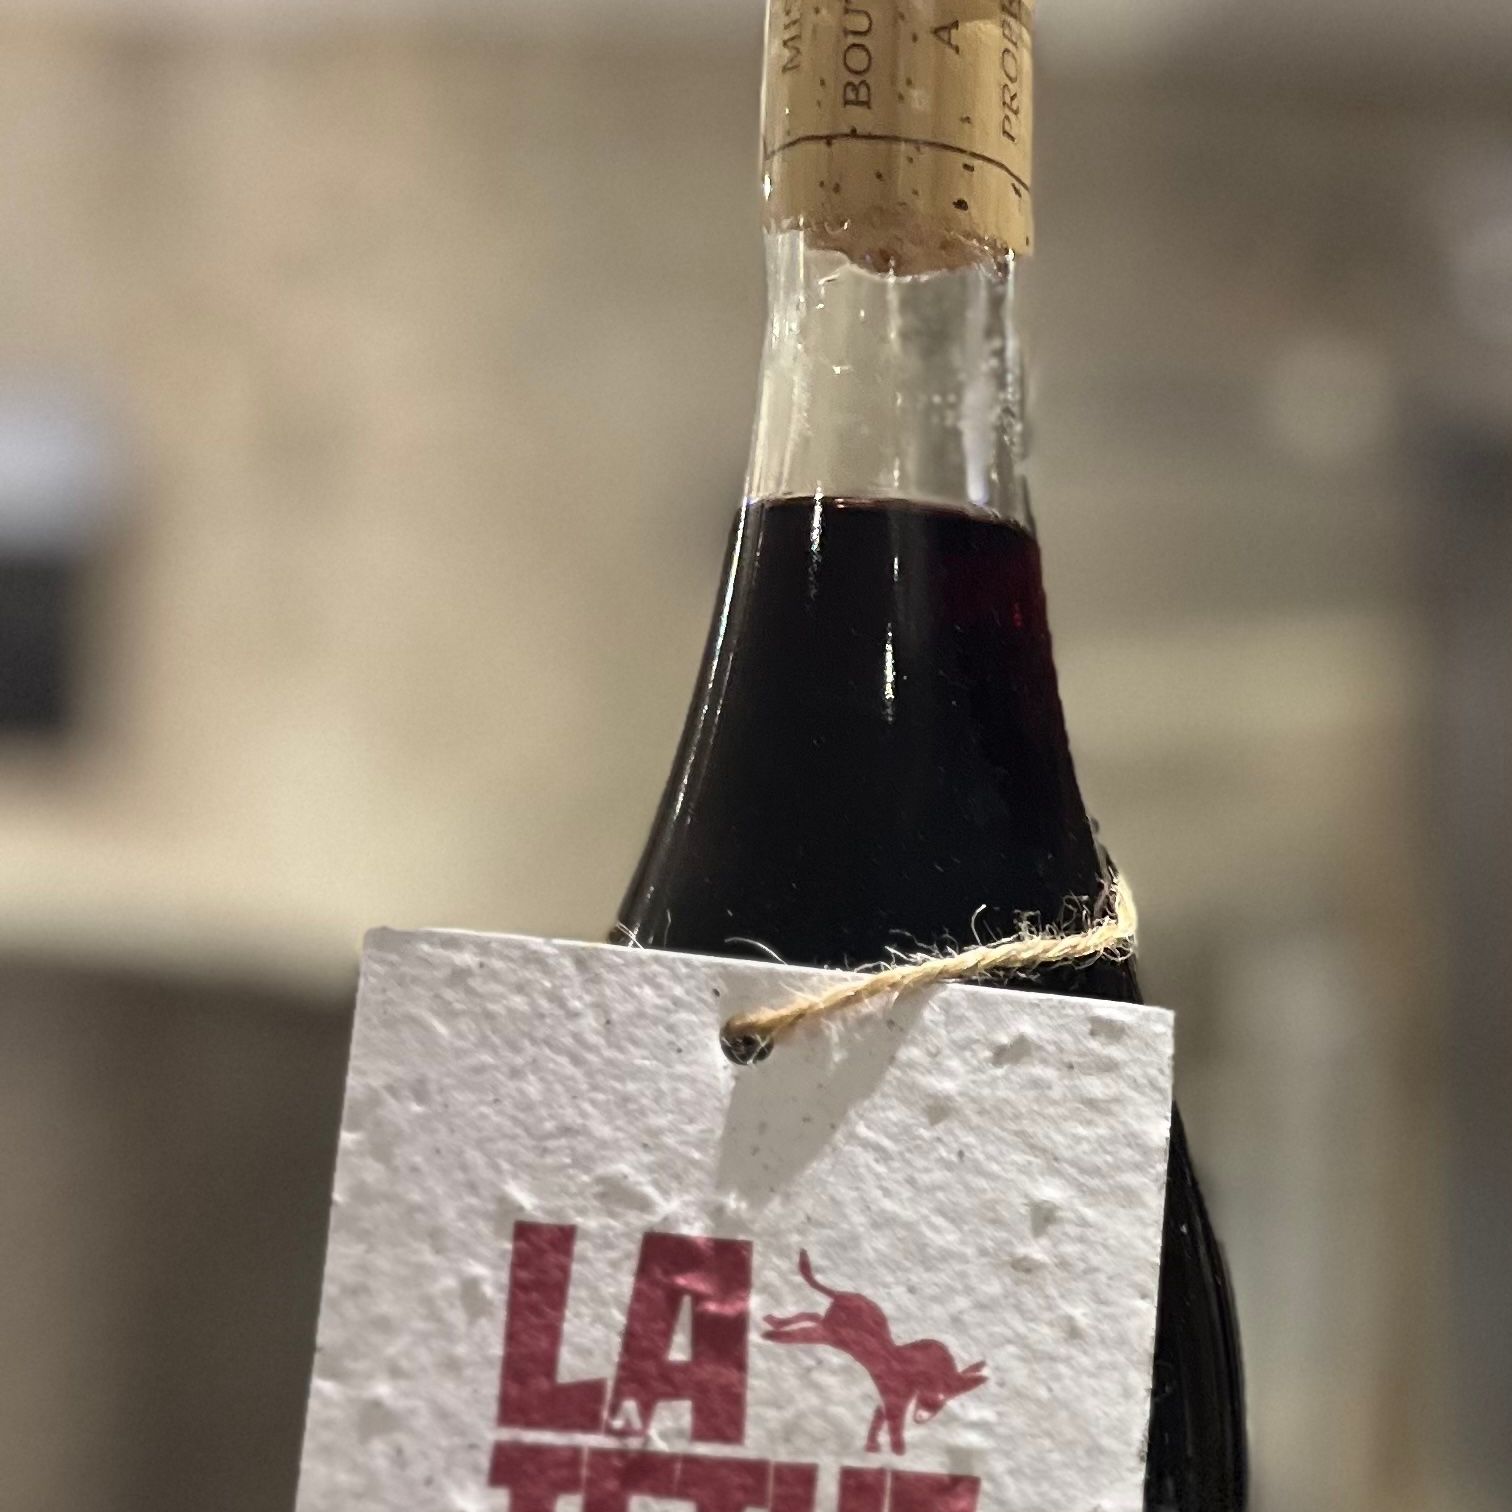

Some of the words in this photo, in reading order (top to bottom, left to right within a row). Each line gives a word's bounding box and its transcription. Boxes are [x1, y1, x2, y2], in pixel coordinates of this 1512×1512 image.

[842, 0, 873, 110] BOU
[930, 18, 960, 55] A
[496, 1220, 754, 1446] LA
